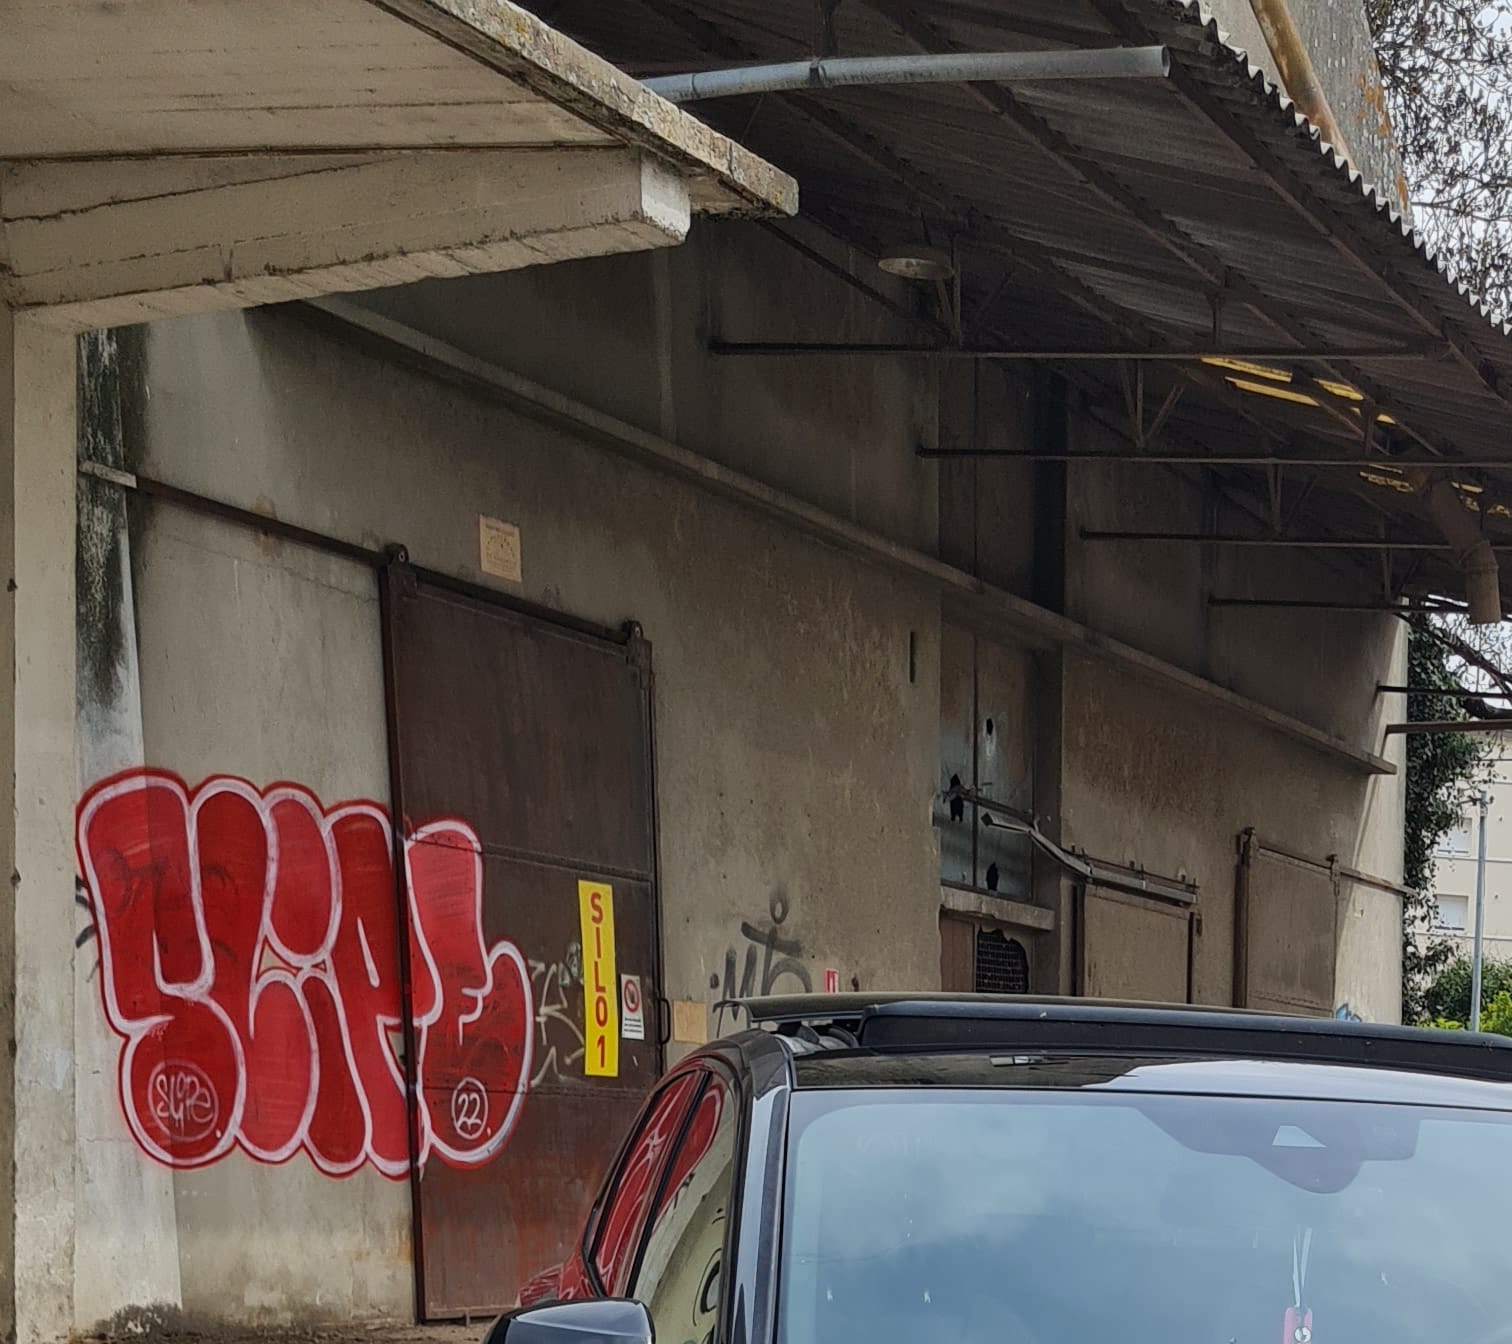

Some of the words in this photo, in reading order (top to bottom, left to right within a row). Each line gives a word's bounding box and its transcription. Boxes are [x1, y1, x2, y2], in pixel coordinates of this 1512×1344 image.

[590, 892, 608, 1027] SILO
[597, 1035, 605, 1068] 1
[456, 1092, 482, 1130] 22
